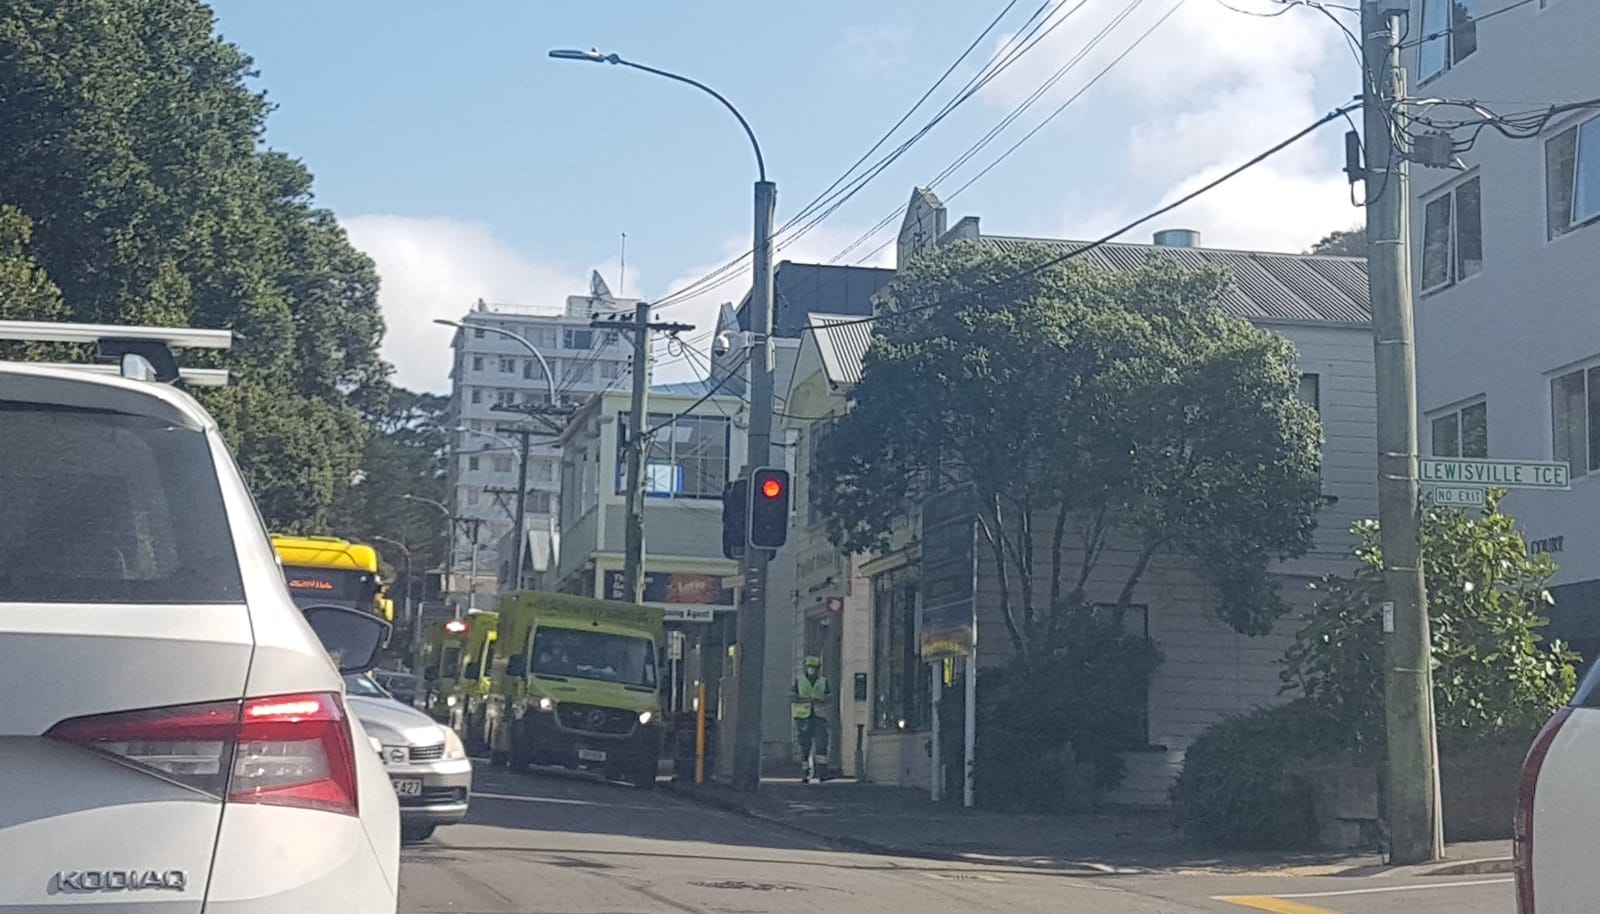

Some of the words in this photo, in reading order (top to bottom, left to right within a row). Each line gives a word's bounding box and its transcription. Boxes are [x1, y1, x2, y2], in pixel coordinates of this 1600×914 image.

[1423, 462, 1522, 482] LEWISVILLE
[1534, 466, 1563, 484] TCE
[1438, 489, 1451, 501] NO
[1458, 490, 1480, 502] EXIT
[677, 580, 706, 593] Lotto
[54, 869, 187, 893] KODIAQ
